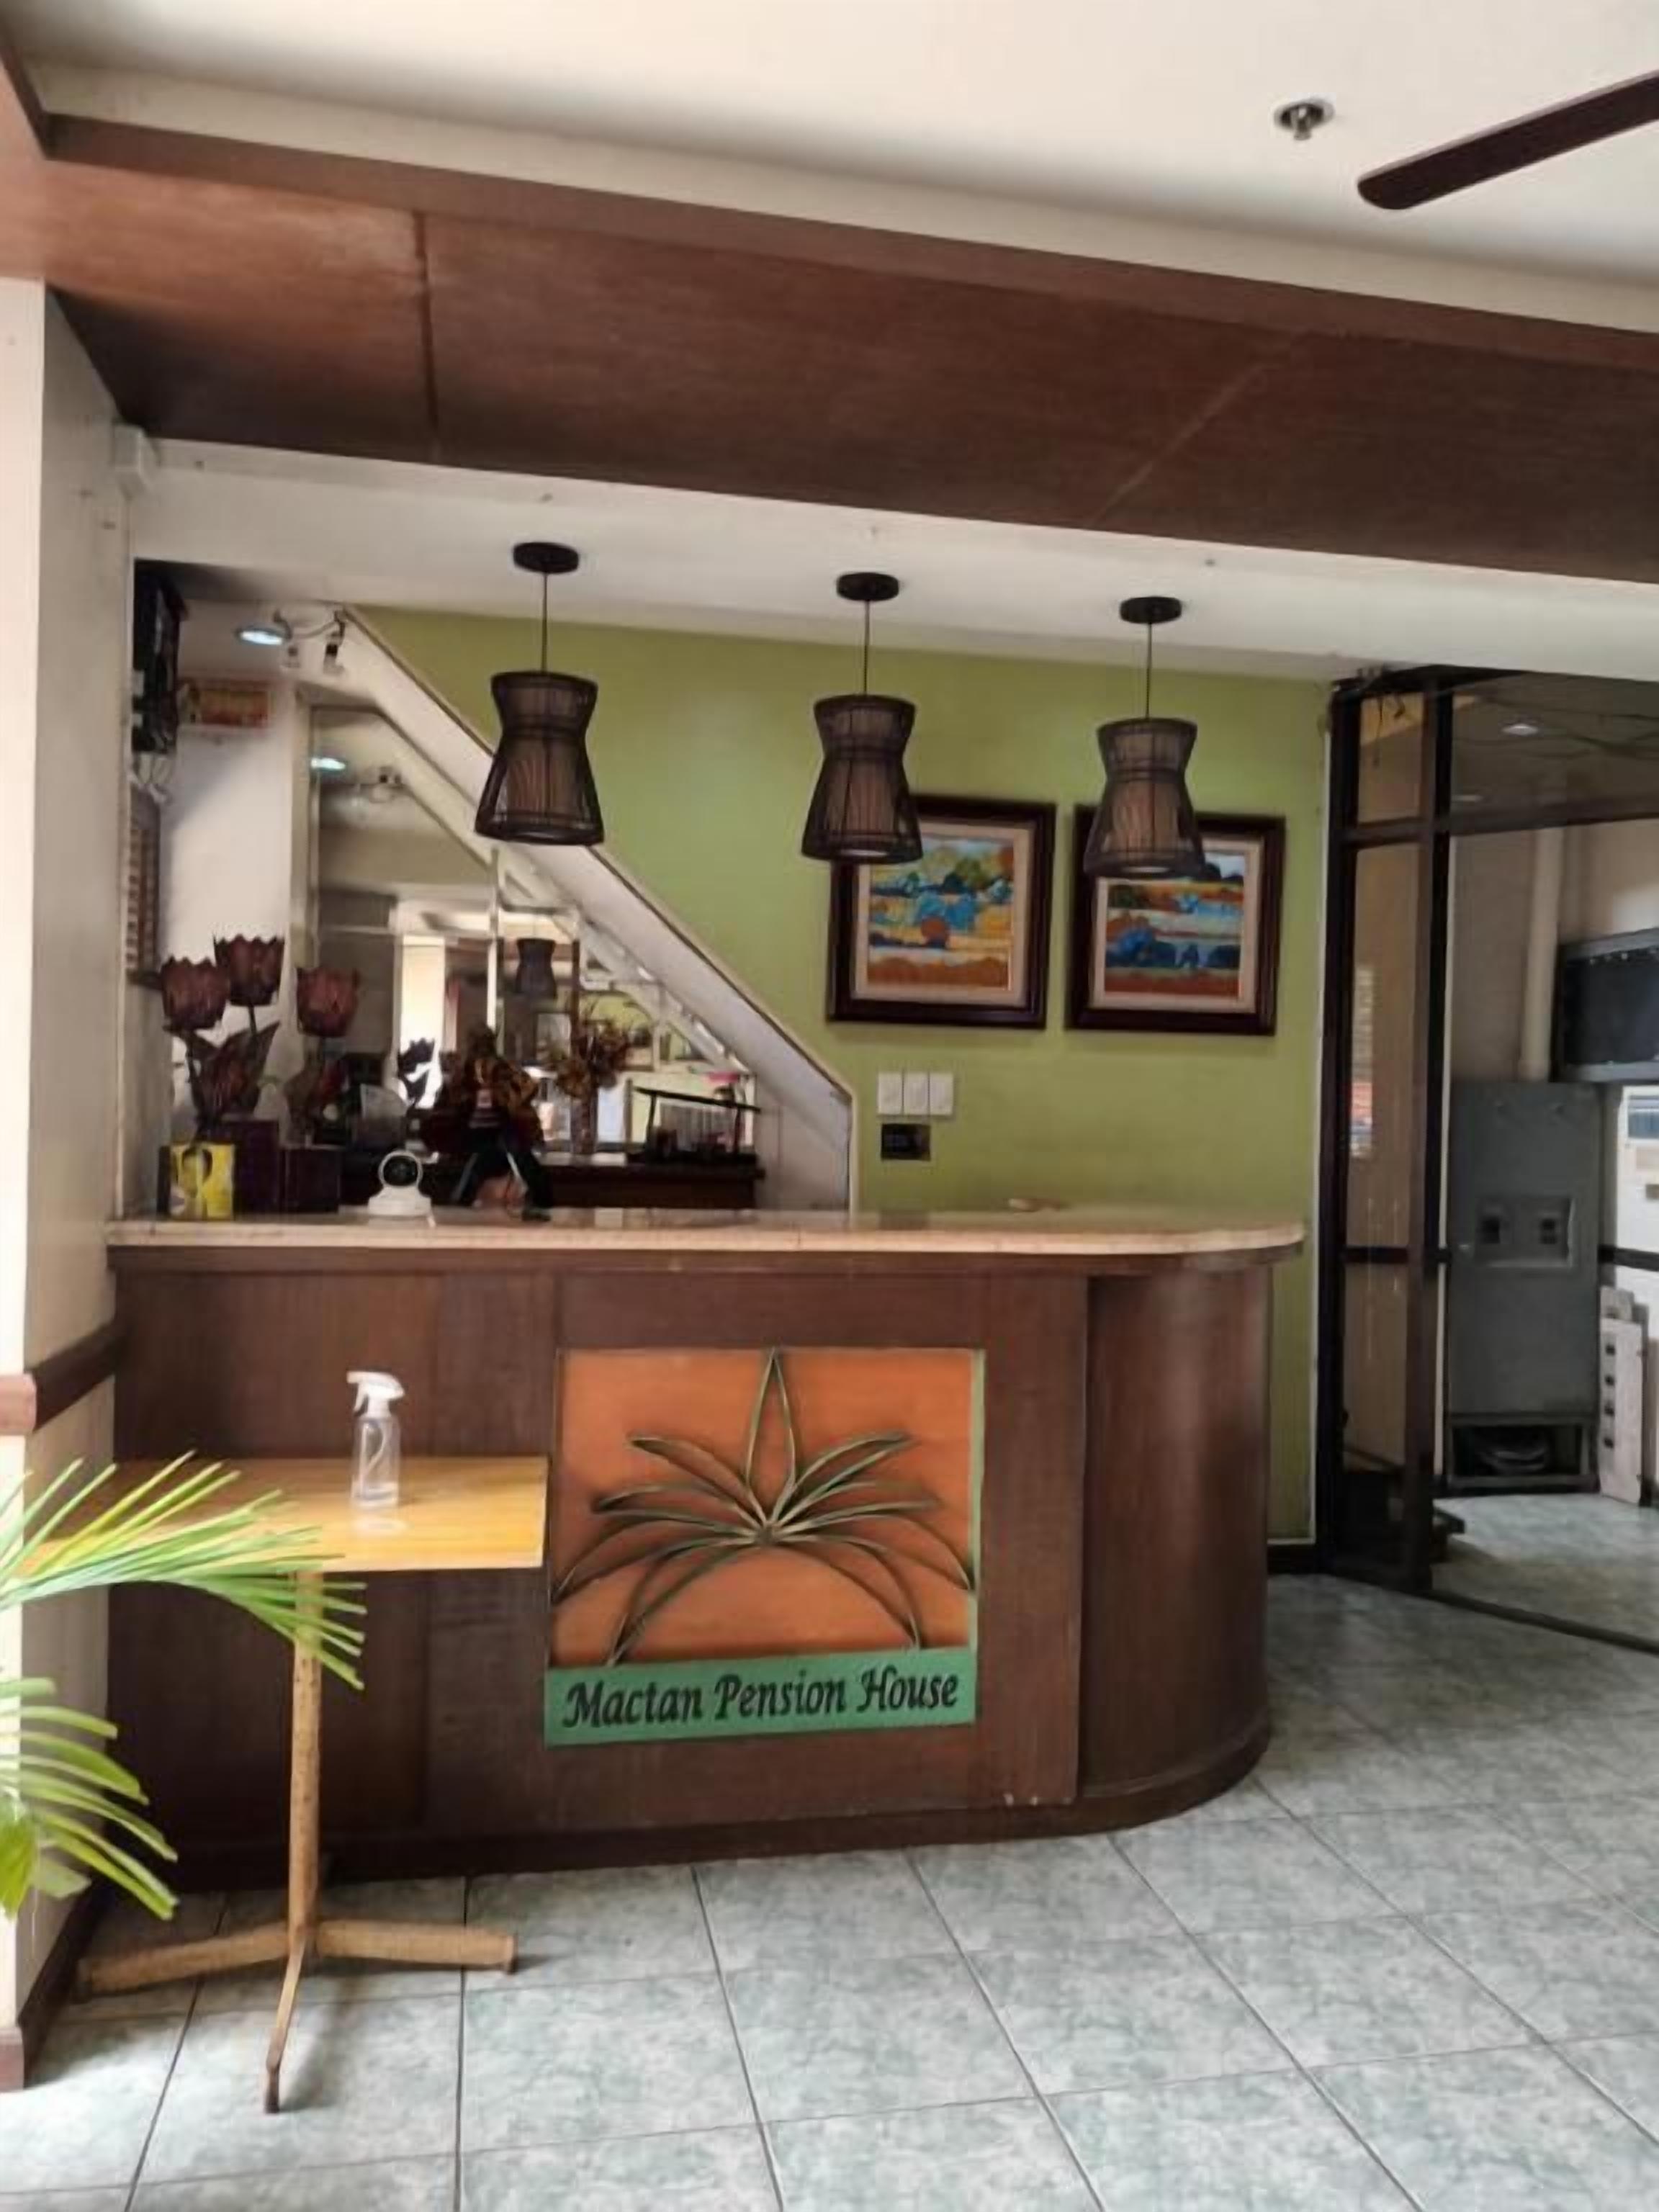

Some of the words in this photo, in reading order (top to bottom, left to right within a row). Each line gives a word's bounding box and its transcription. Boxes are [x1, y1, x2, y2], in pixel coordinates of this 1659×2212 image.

[563, 1681, 703, 1728] Mactan
[714, 1670, 846, 1720] Pension
[857, 1664, 958, 1712] House
